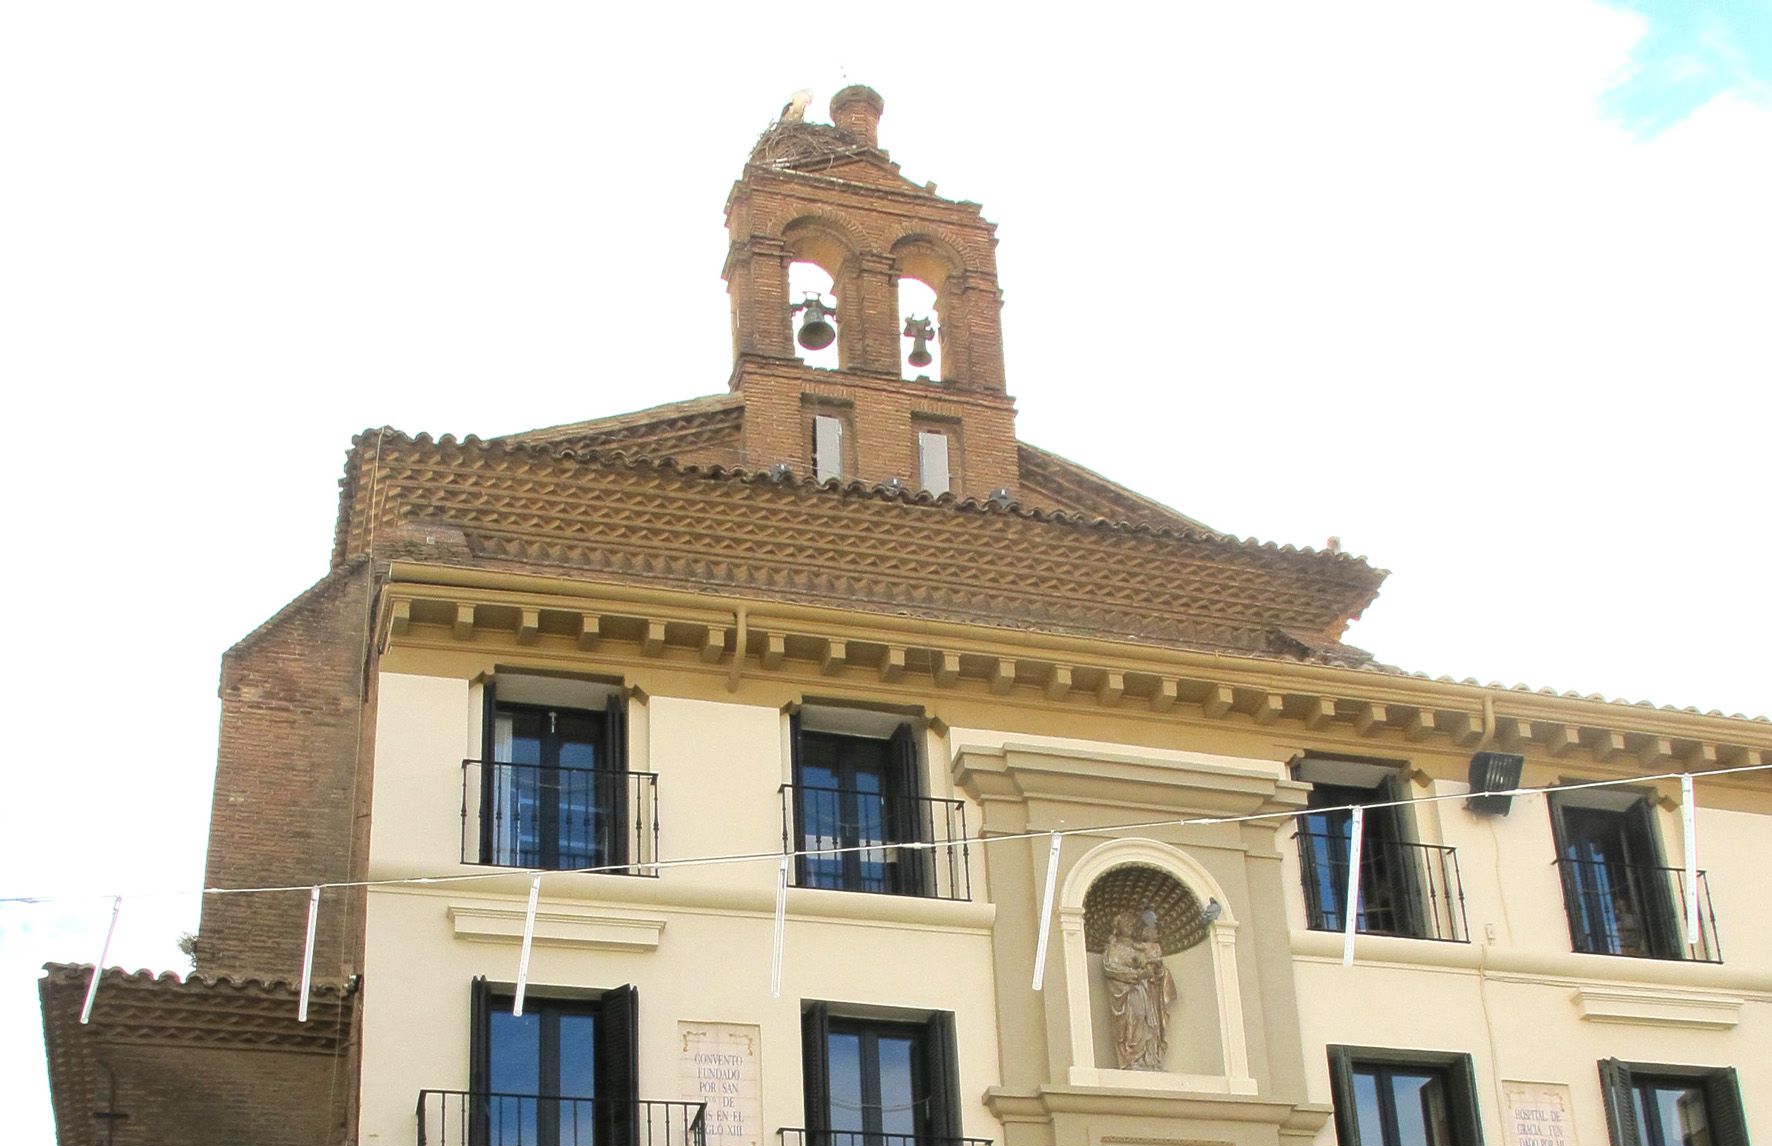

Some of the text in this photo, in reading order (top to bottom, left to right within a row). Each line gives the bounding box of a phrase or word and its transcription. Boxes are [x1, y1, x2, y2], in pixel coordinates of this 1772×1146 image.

[694, 1053, 743, 1067] CONVENTO
[697, 1067, 741, 1081] FUNDADO
[700, 1081, 739, 1094] POR SAN
[722, 1096, 736, 1108] DE
[716, 1110, 729, 1122] EN
[733, 1111, 745, 1122] EL
[1514, 1108, 1561, 1122] HOSPITAL DE
[727, 1125, 743, 1137] XIII
[1516, 1123, 1543, 1136] GRACIA
